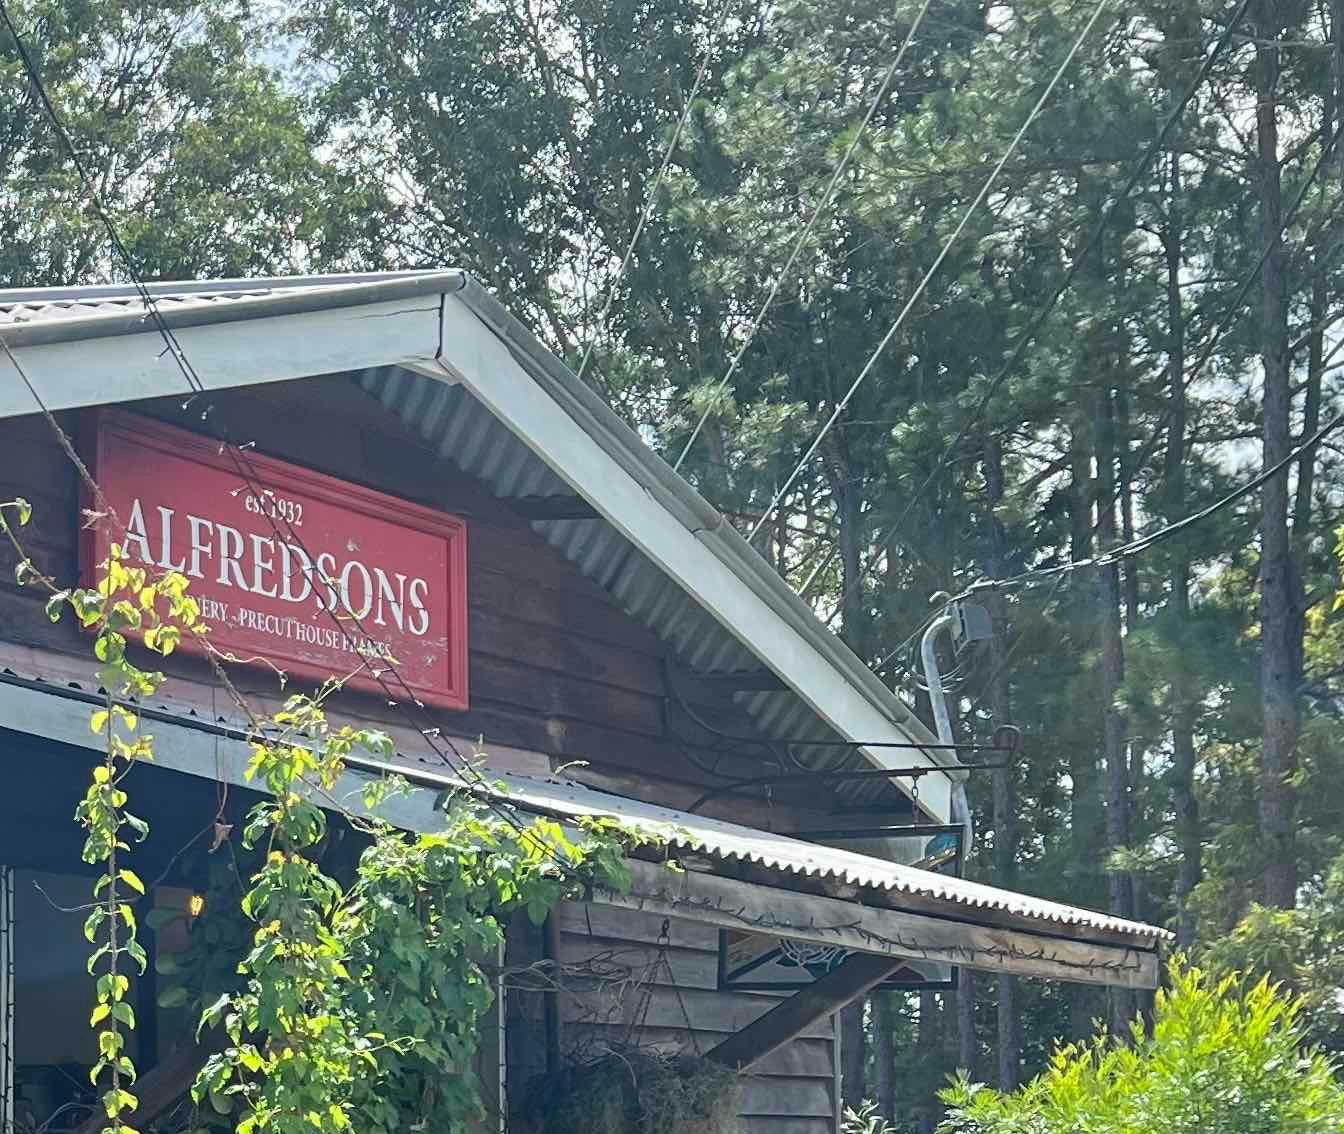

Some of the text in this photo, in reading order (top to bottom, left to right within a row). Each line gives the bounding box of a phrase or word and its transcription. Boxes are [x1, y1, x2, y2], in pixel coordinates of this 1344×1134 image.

[271, 496, 303, 527] 1932
[120, 498, 430, 637] ALFREDSONS
[296, 622, 340, 650] HOUSE
